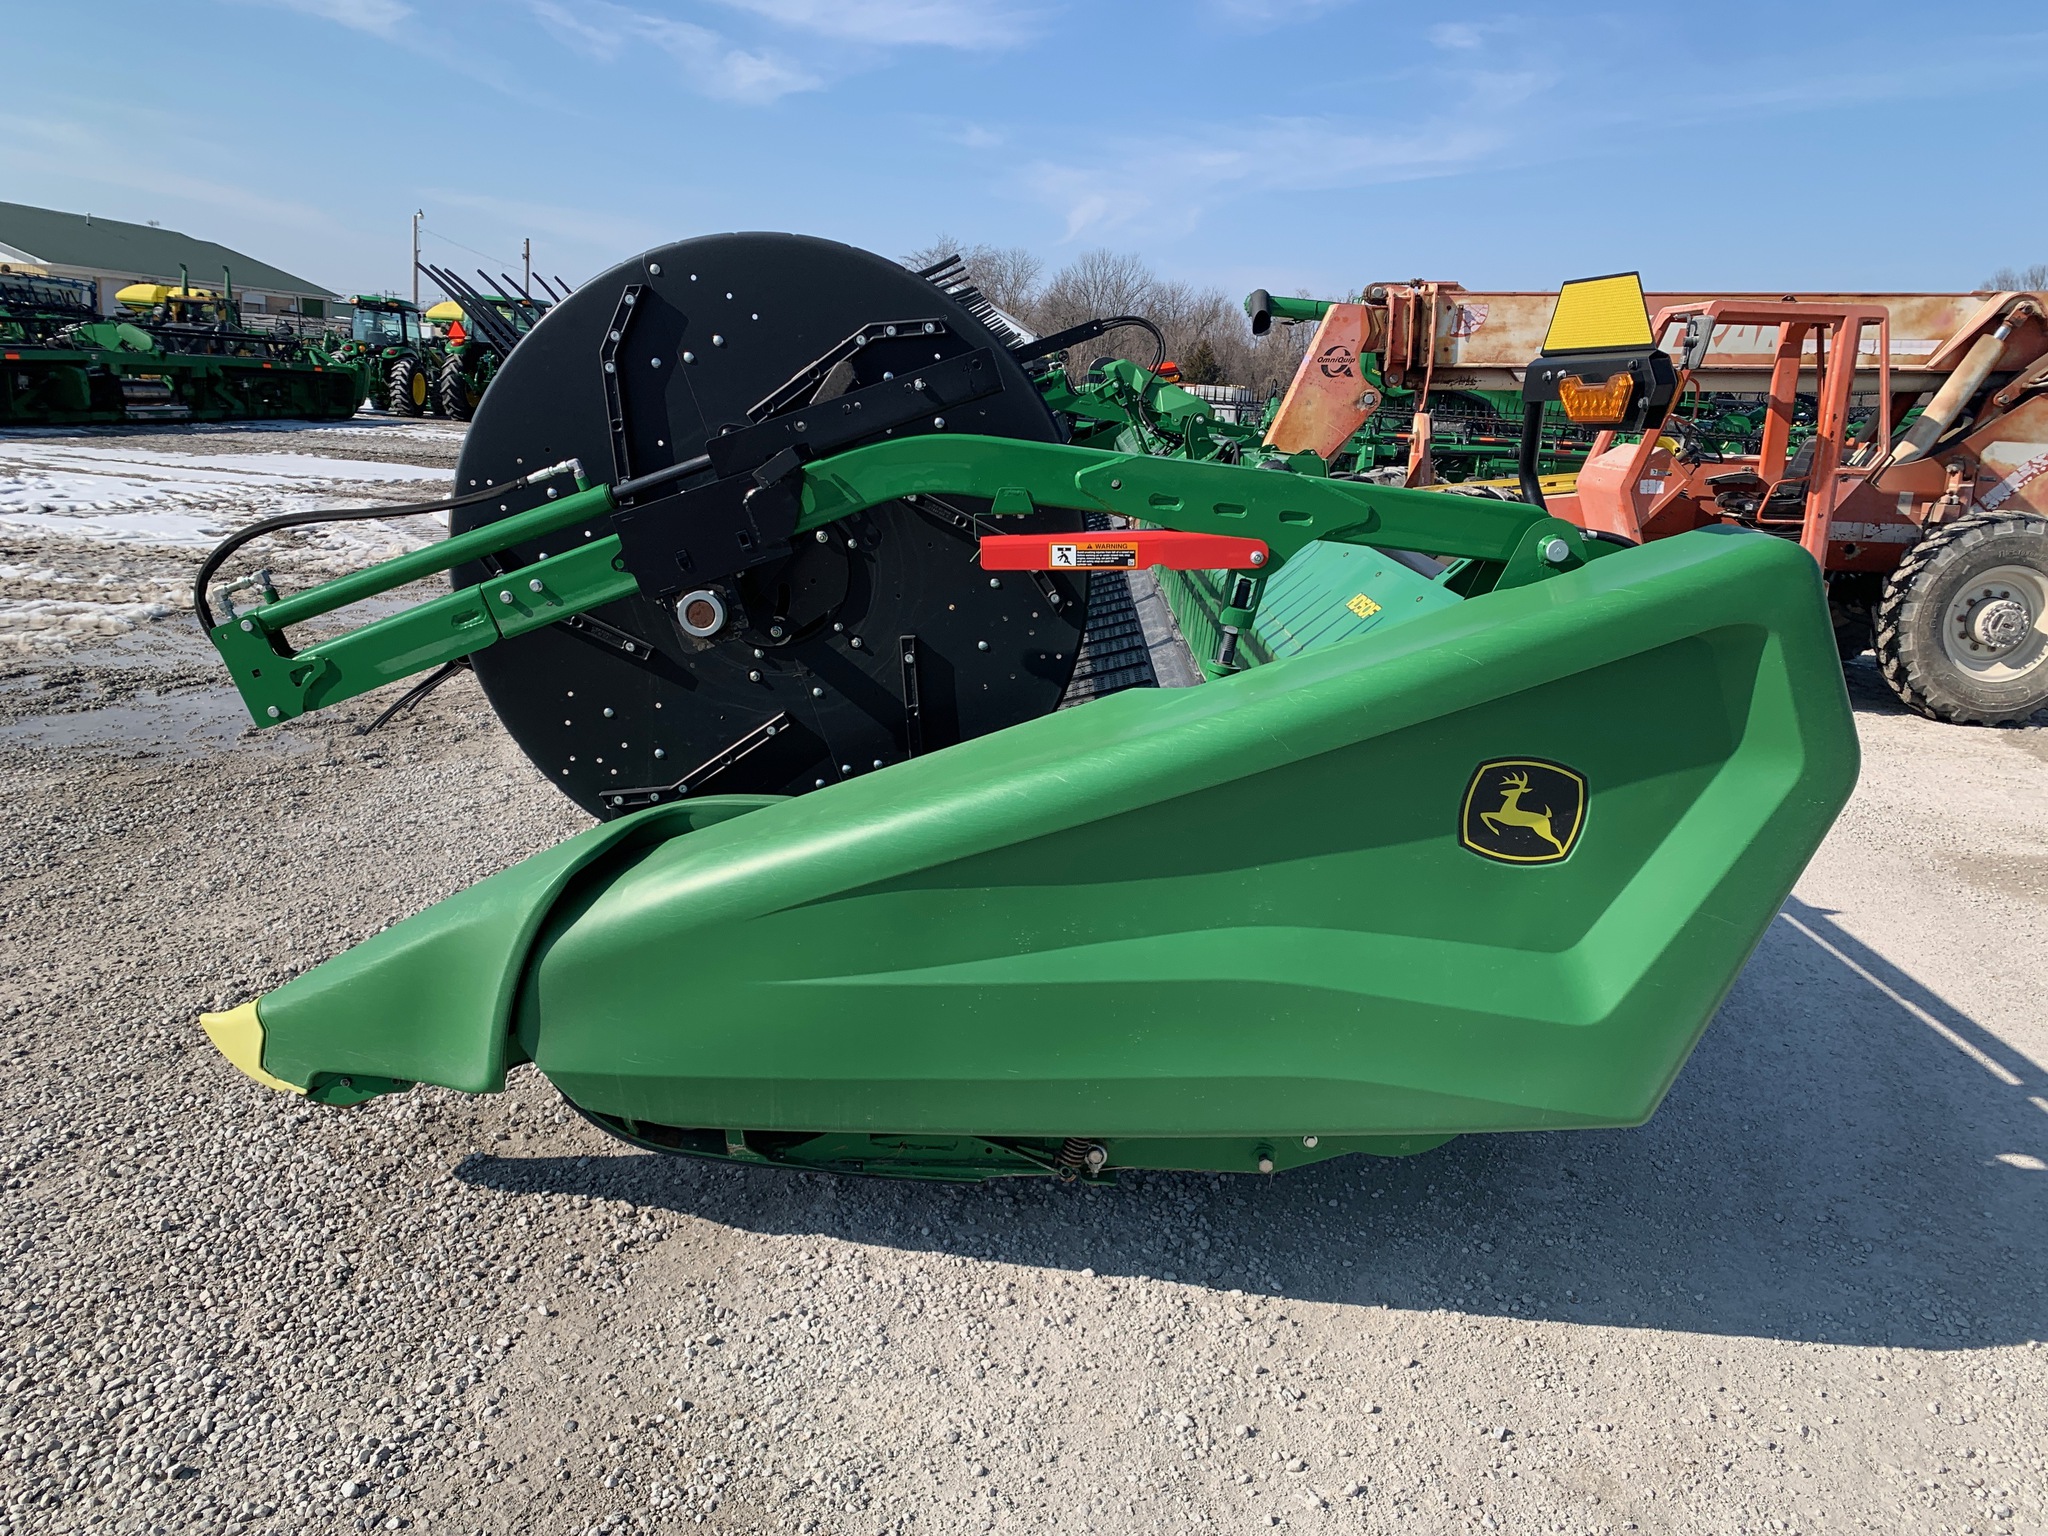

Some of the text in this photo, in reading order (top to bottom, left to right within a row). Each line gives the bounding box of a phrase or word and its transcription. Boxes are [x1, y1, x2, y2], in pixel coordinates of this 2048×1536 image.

[1317, 356, 1356, 364] OmniQuip
[842, 402, 852, 416] 2
[1345, 592, 1383, 619] HD50F
